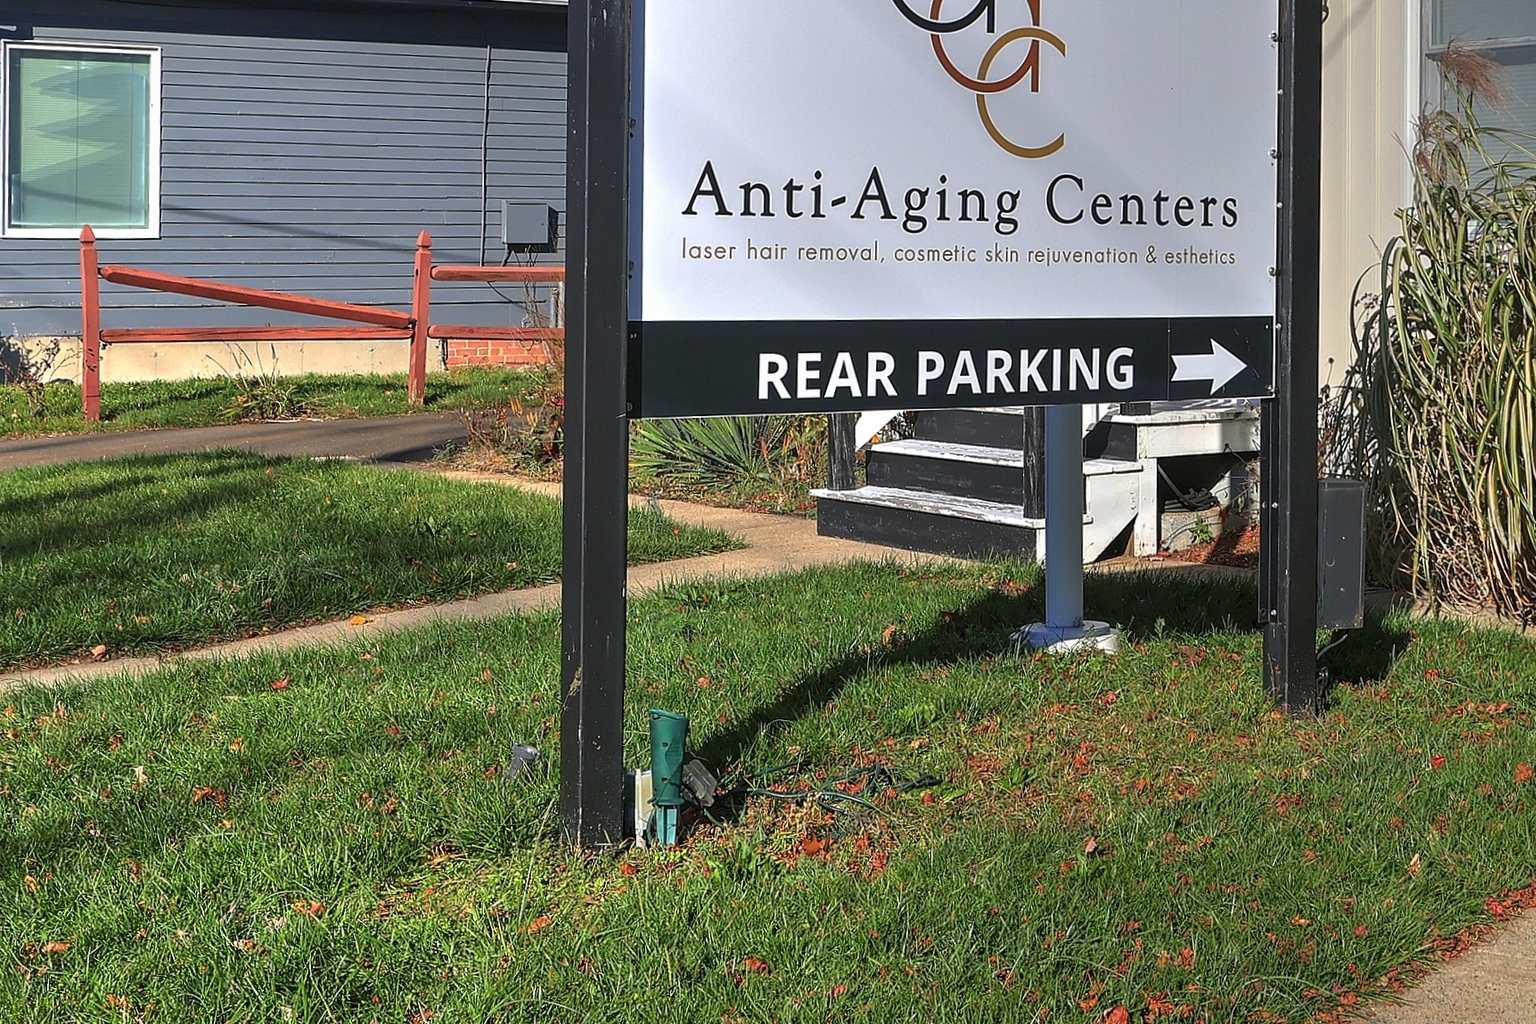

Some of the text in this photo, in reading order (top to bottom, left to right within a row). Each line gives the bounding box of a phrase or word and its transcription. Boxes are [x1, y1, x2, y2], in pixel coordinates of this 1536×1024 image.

[681, 160, 1239, 236] Anti-Aging Centers
[682, 237, 1236, 267] laser hair removal, cosmetic skin rejuvenation & esthetics
[757, 346, 1135, 400] REAR PARKING
